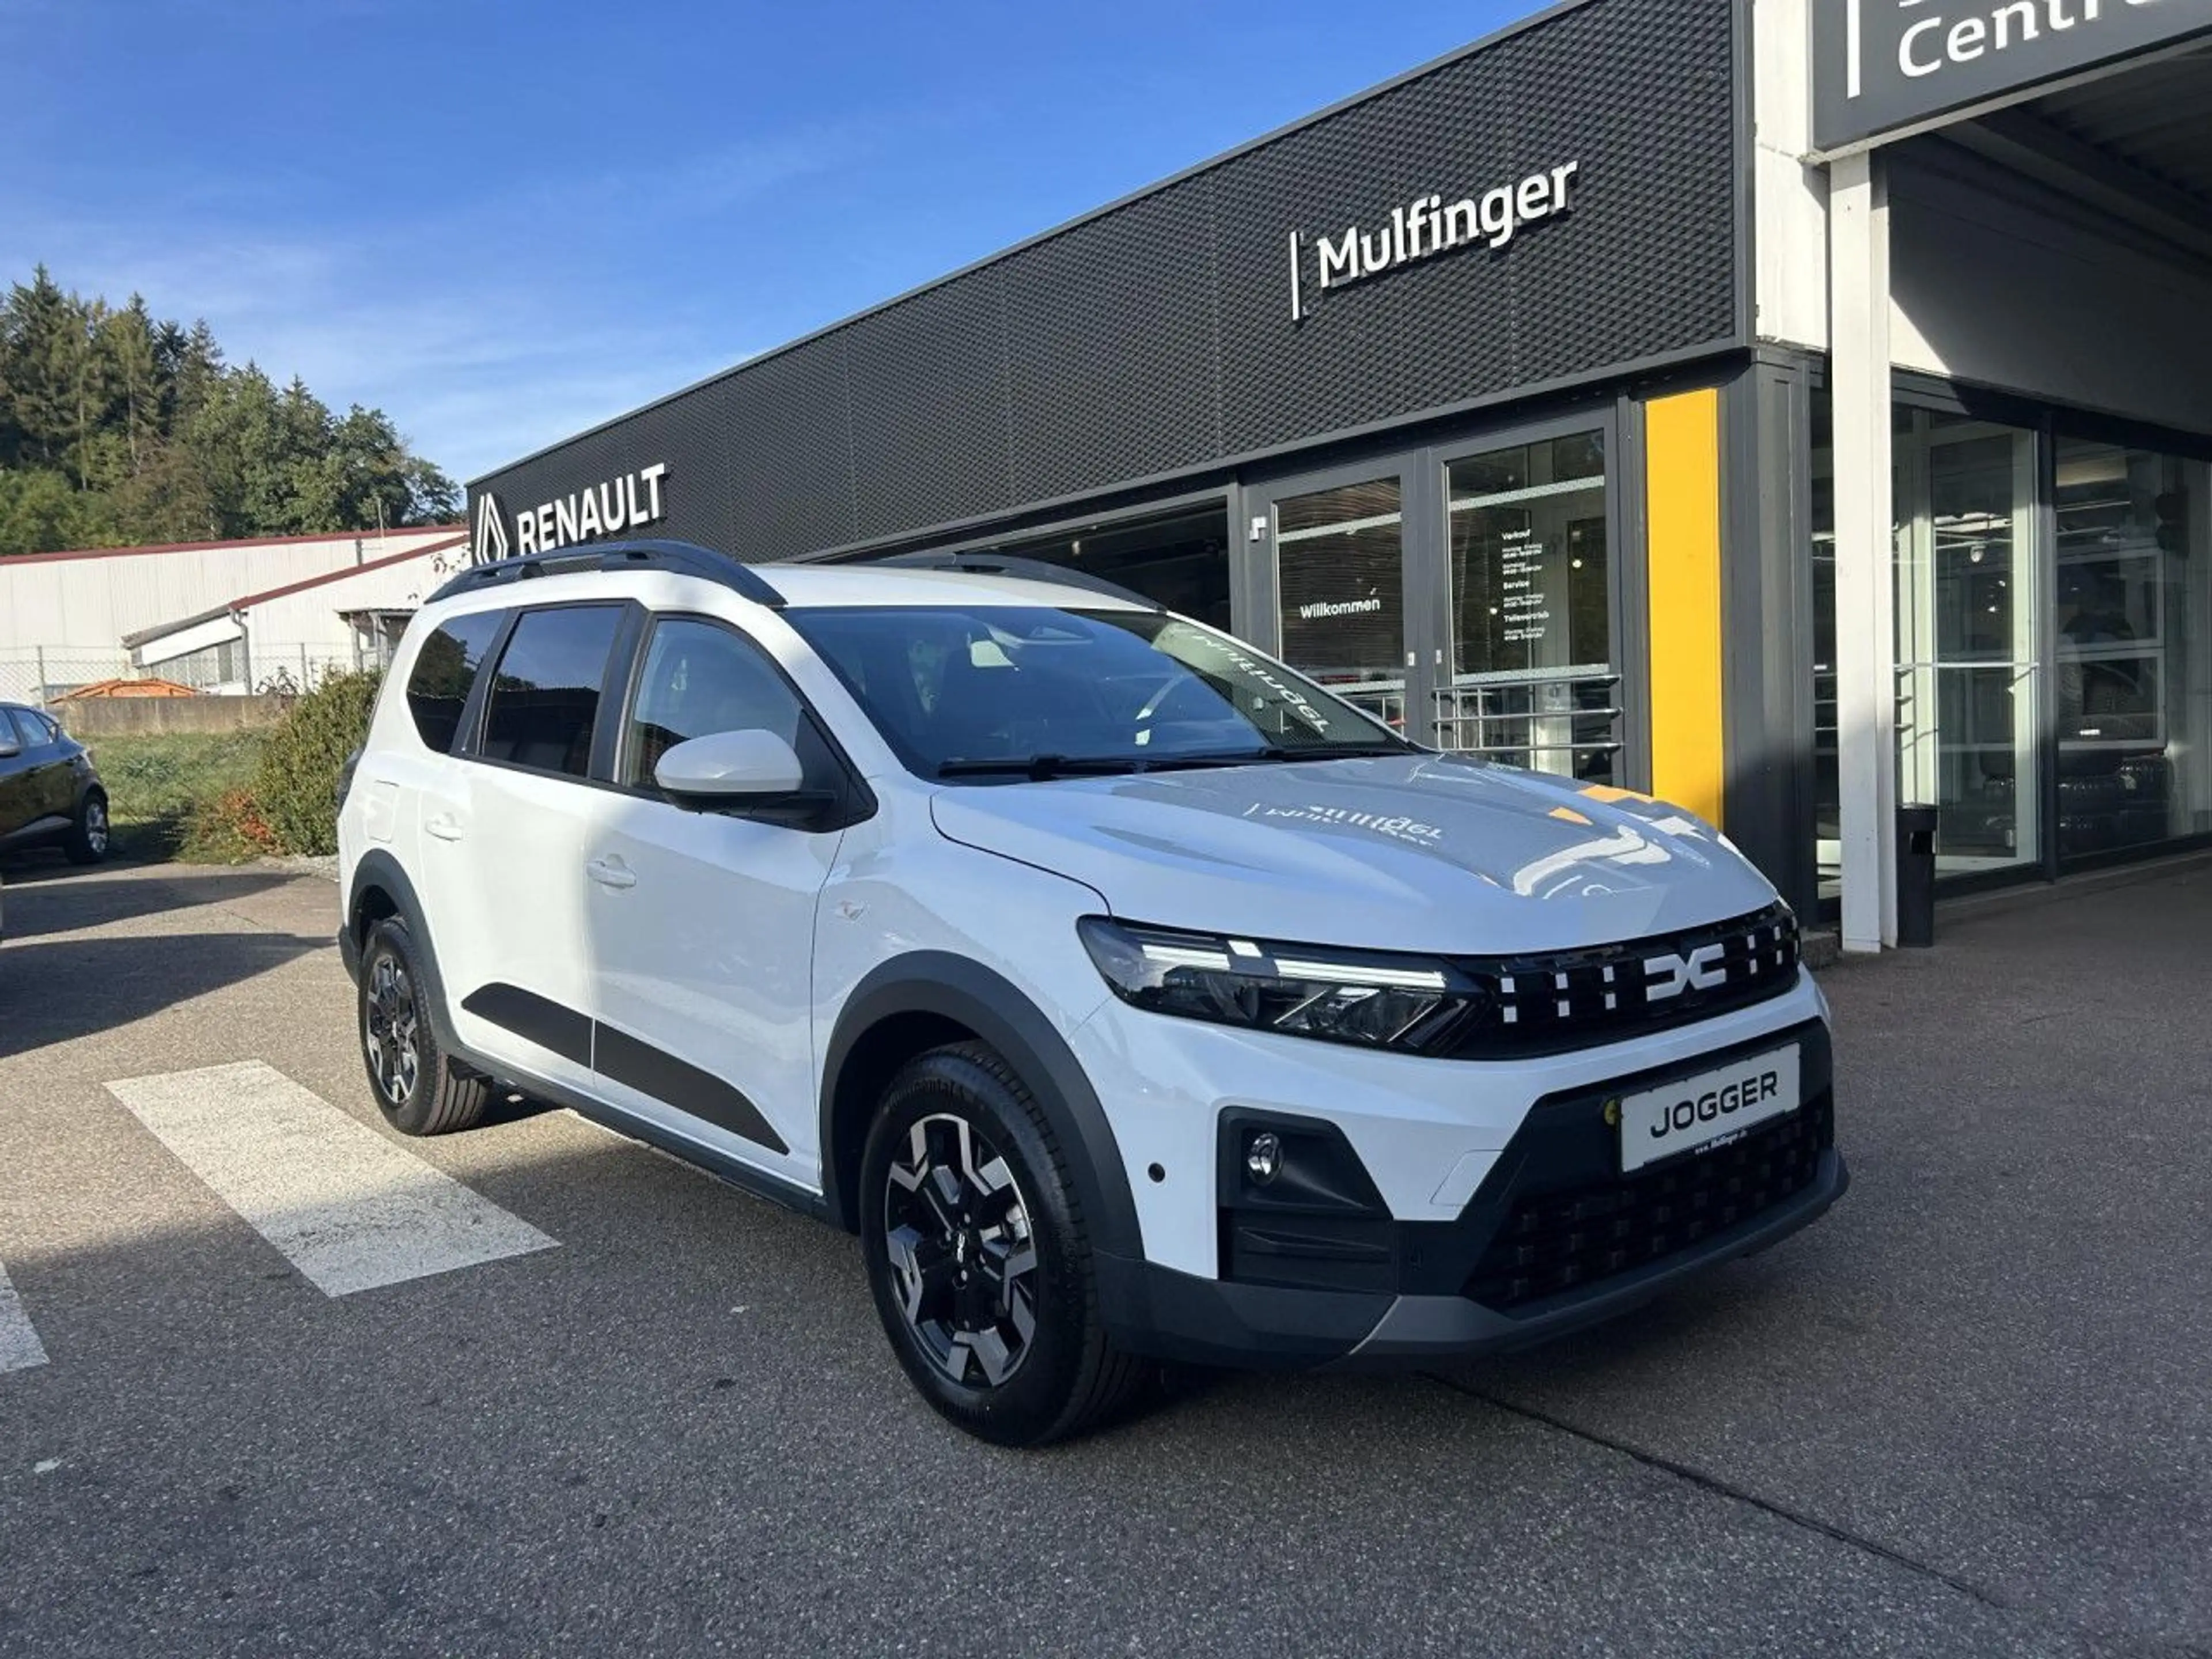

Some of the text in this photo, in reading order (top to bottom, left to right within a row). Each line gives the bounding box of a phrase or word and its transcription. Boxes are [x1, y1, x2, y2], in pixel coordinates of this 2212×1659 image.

[1899, 0, 2162, 77] Cent
[1317, 161, 1578, 288] Mulfinger
[517, 463, 665, 556] RENAULT
[1300, 598, 1381, 619] Willkommen
[1650, 1071, 1777, 1138] JOGGER
